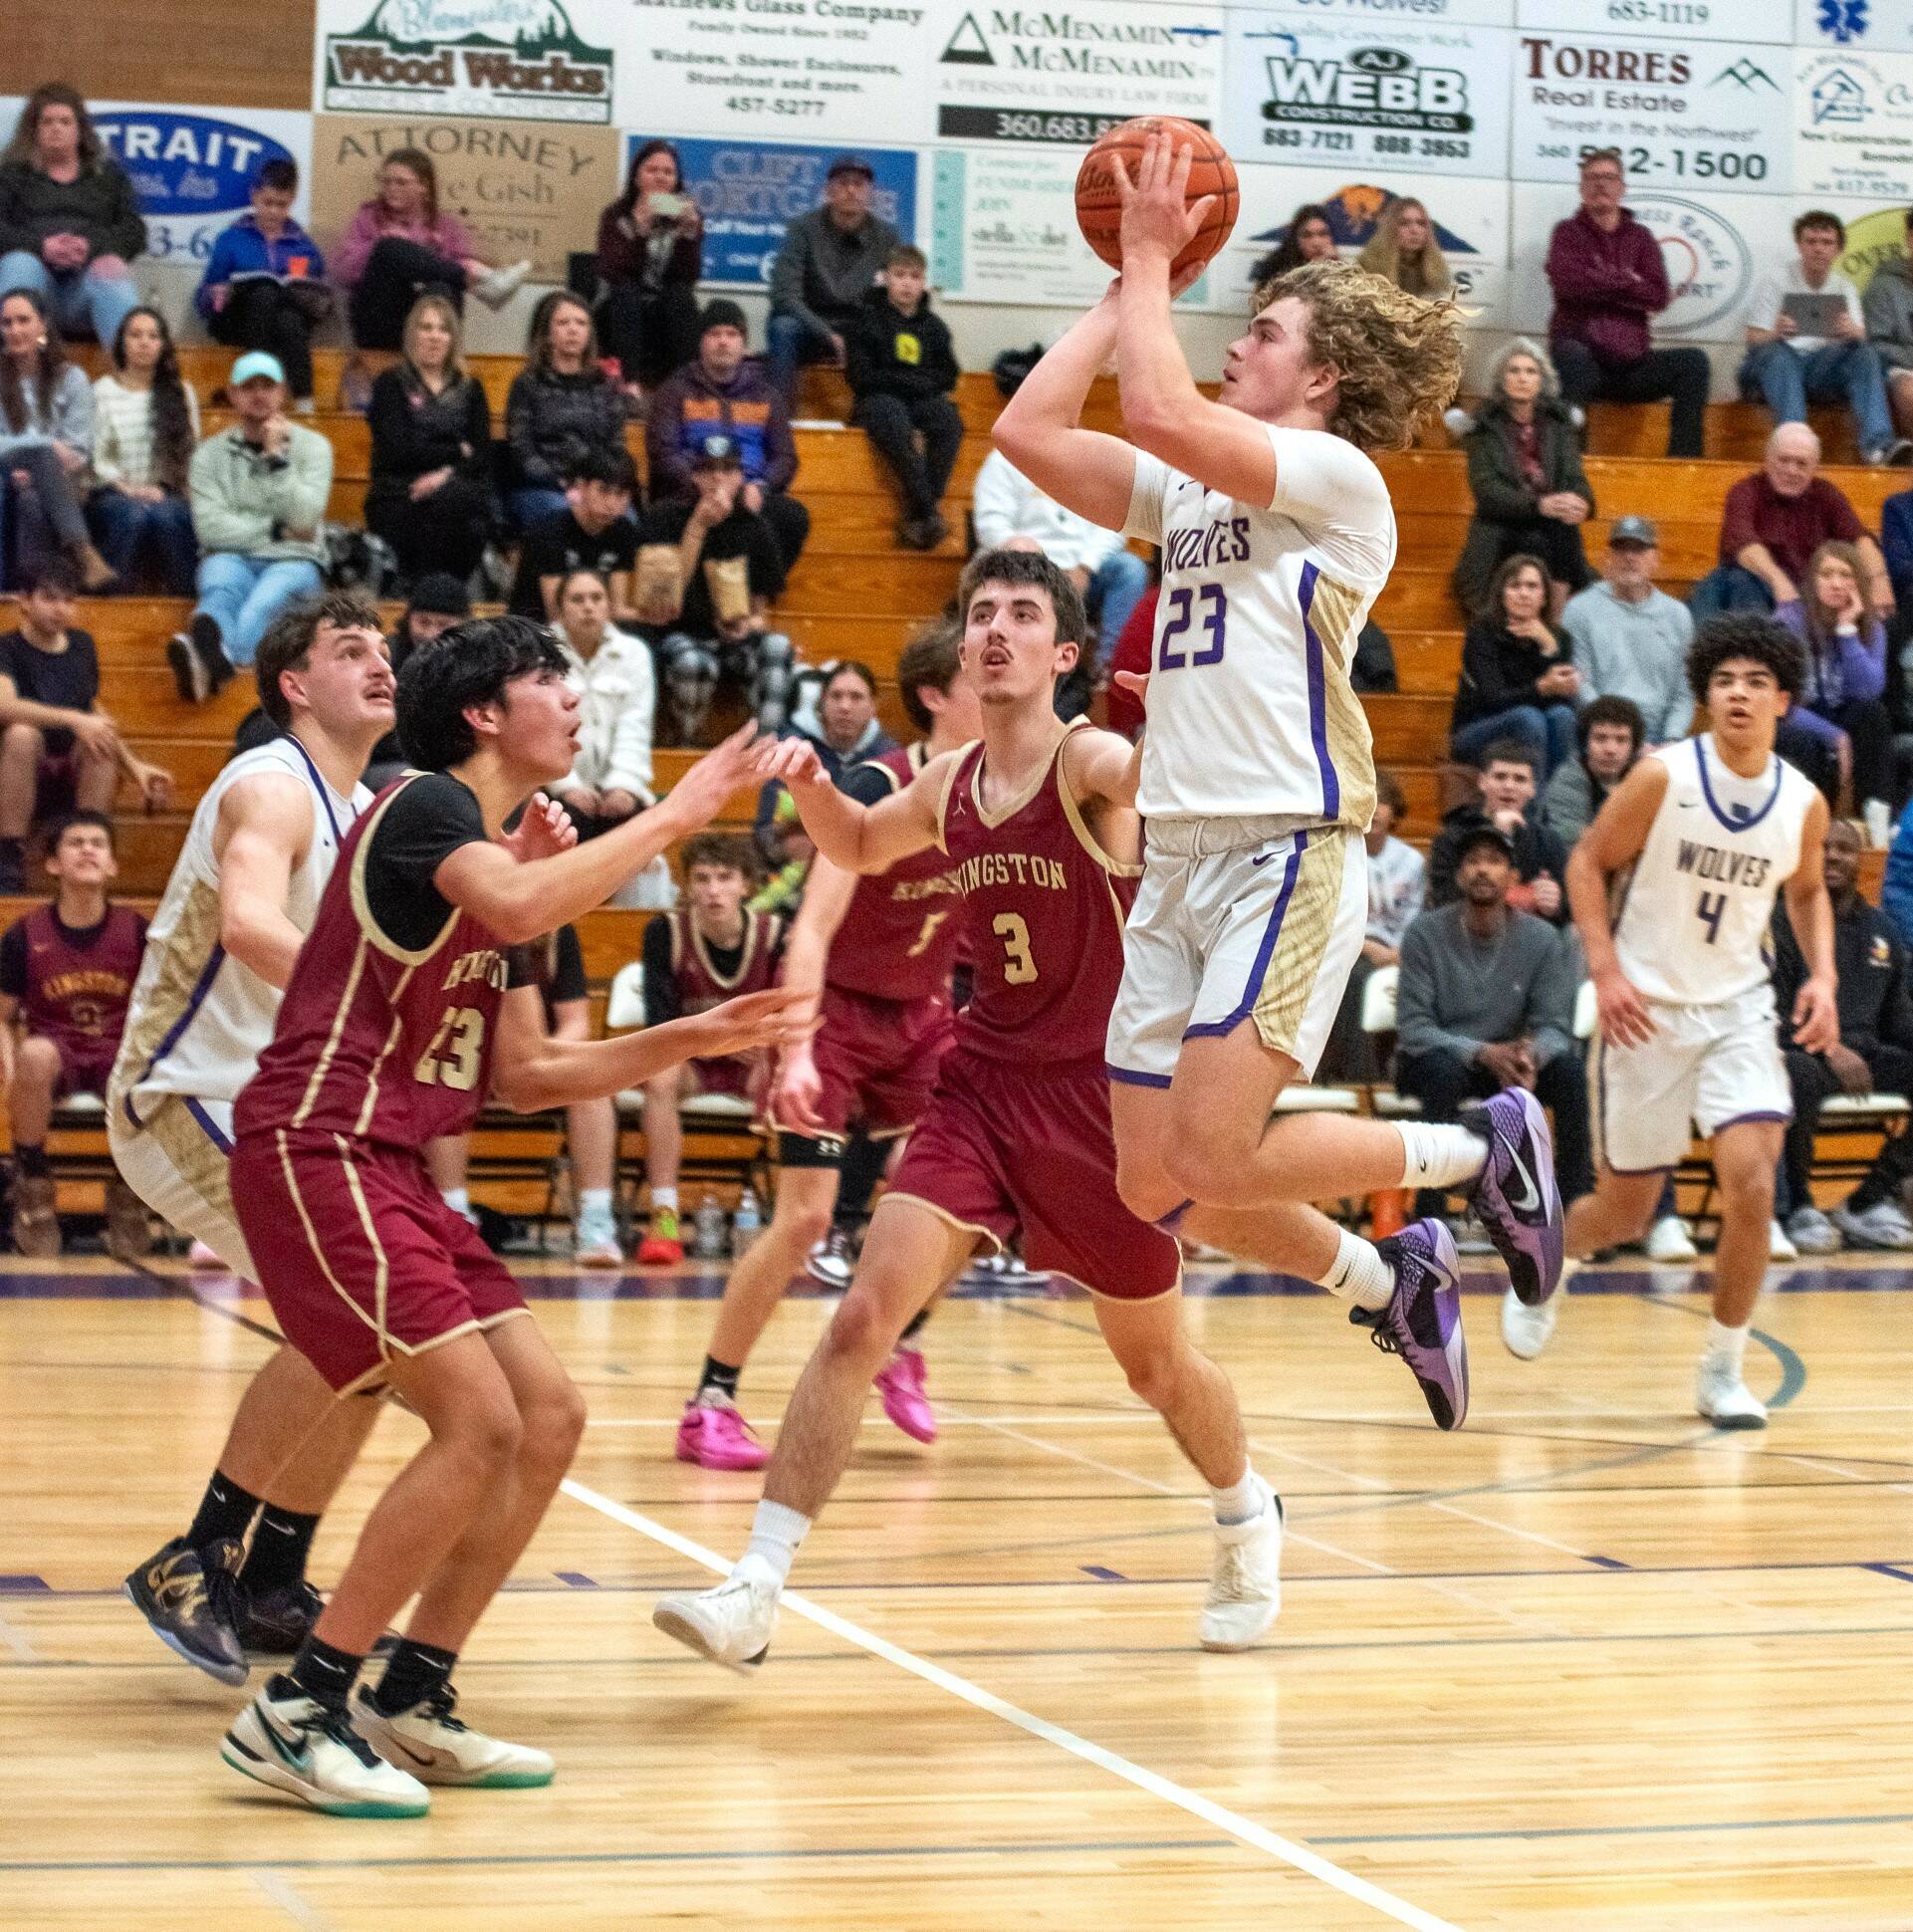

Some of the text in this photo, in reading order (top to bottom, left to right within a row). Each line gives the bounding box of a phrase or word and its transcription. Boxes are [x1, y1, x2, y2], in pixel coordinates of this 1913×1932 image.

[747, 0, 806, 15] Glass
[814, 1, 925, 26] Company
[1606, 0, 1710, 24] 683-1119
[741, 22, 788, 36] Owned
[793, 25, 829, 38] Since
[335, 45, 605, 95] Wood Works
[650, 49, 902, 76] Windows, Shower Enclosures,
[1361, 52, 1400, 70] AJ
[1522, 37, 1692, 86] TORRES
[686, 71, 864, 94] Storefront and more.
[957, 80, 1053, 98] PERSONAL
[1056, 85, 1115, 101] INJURY
[1122, 88, 1161, 103] LAW
[1167, 92, 1209, 106] FIRM
[1266, 56, 1468, 114] WEBB
[726, 97, 827, 117] 457-5277
[1534, 86, 1688, 113] Real Estate
[1276, 105, 1424, 126] CONSTRUCTION
[1607, 121, 1625, 134] in
[1629, 121, 1659, 135] the
[94, 123, 263, 174] TRAIT
[338, 126, 595, 176] ATTORNEY
[476, 173, 554, 202] Gish
[1162, 516, 1252, 575] WOLVES
[1159, 583, 1228, 672] 23
[1674, 839, 1772, 889] WOLVES
[1695, 890, 1728, 946] 4
[992, 912, 1039, 986] 3
